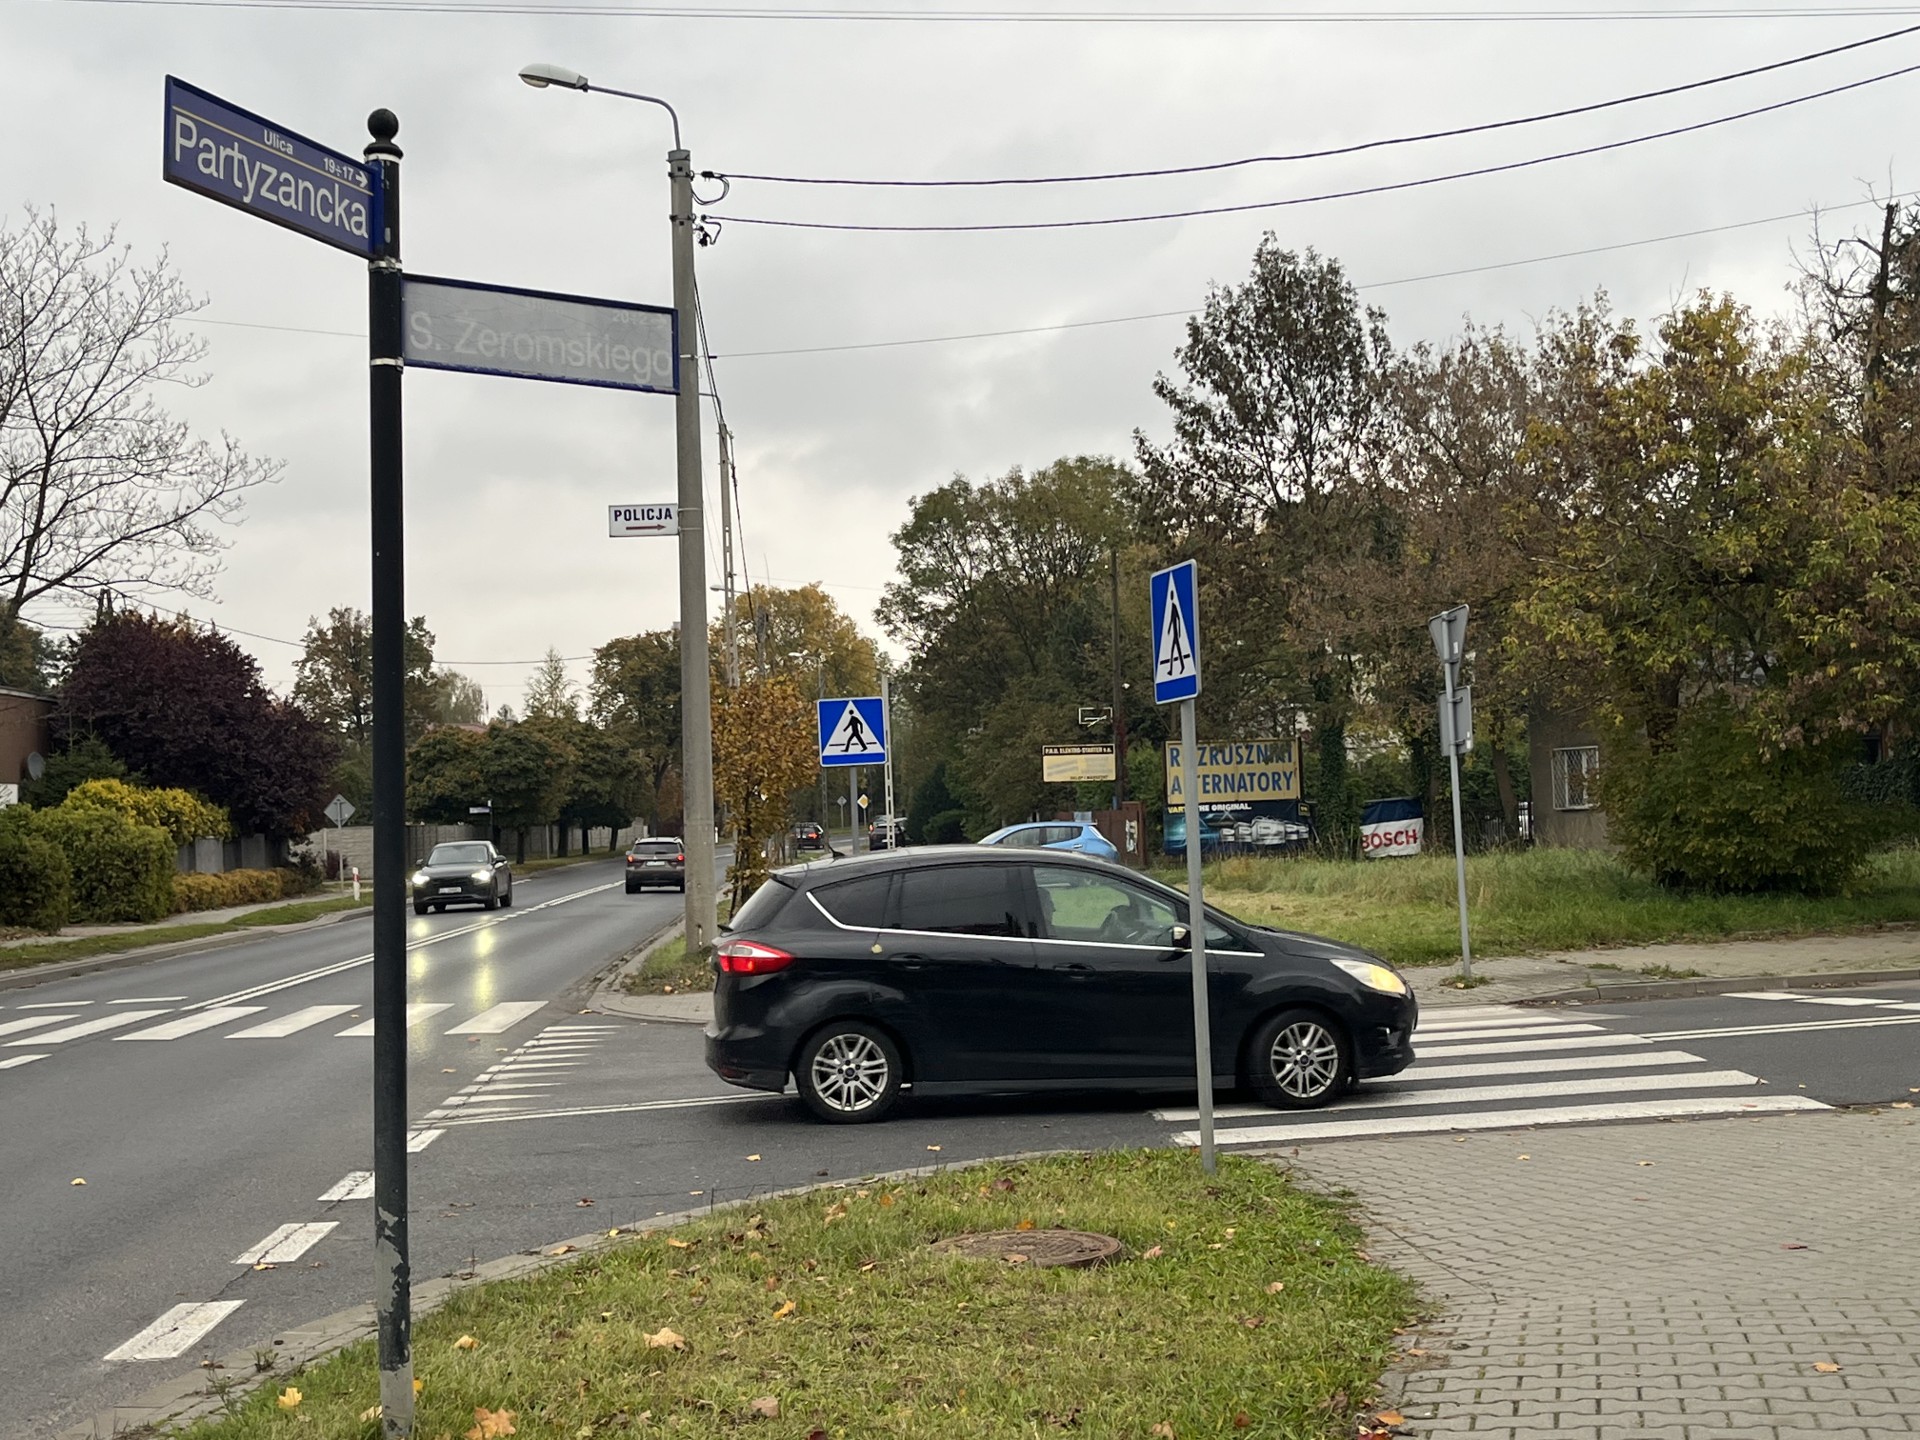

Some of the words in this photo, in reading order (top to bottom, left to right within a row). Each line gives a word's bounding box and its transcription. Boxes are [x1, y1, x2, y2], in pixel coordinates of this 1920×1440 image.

[264, 129, 294, 155] Ulica
[174, 113, 369, 239] Partyzancka
[410, 311, 442, 351] S.
[454, 309, 672, 383] Żeromskiego
[614, 508, 673, 521] POLICJA
[1171, 771, 1293, 795] AERNATORY
[1361, 829, 1417, 850] BOSCH
